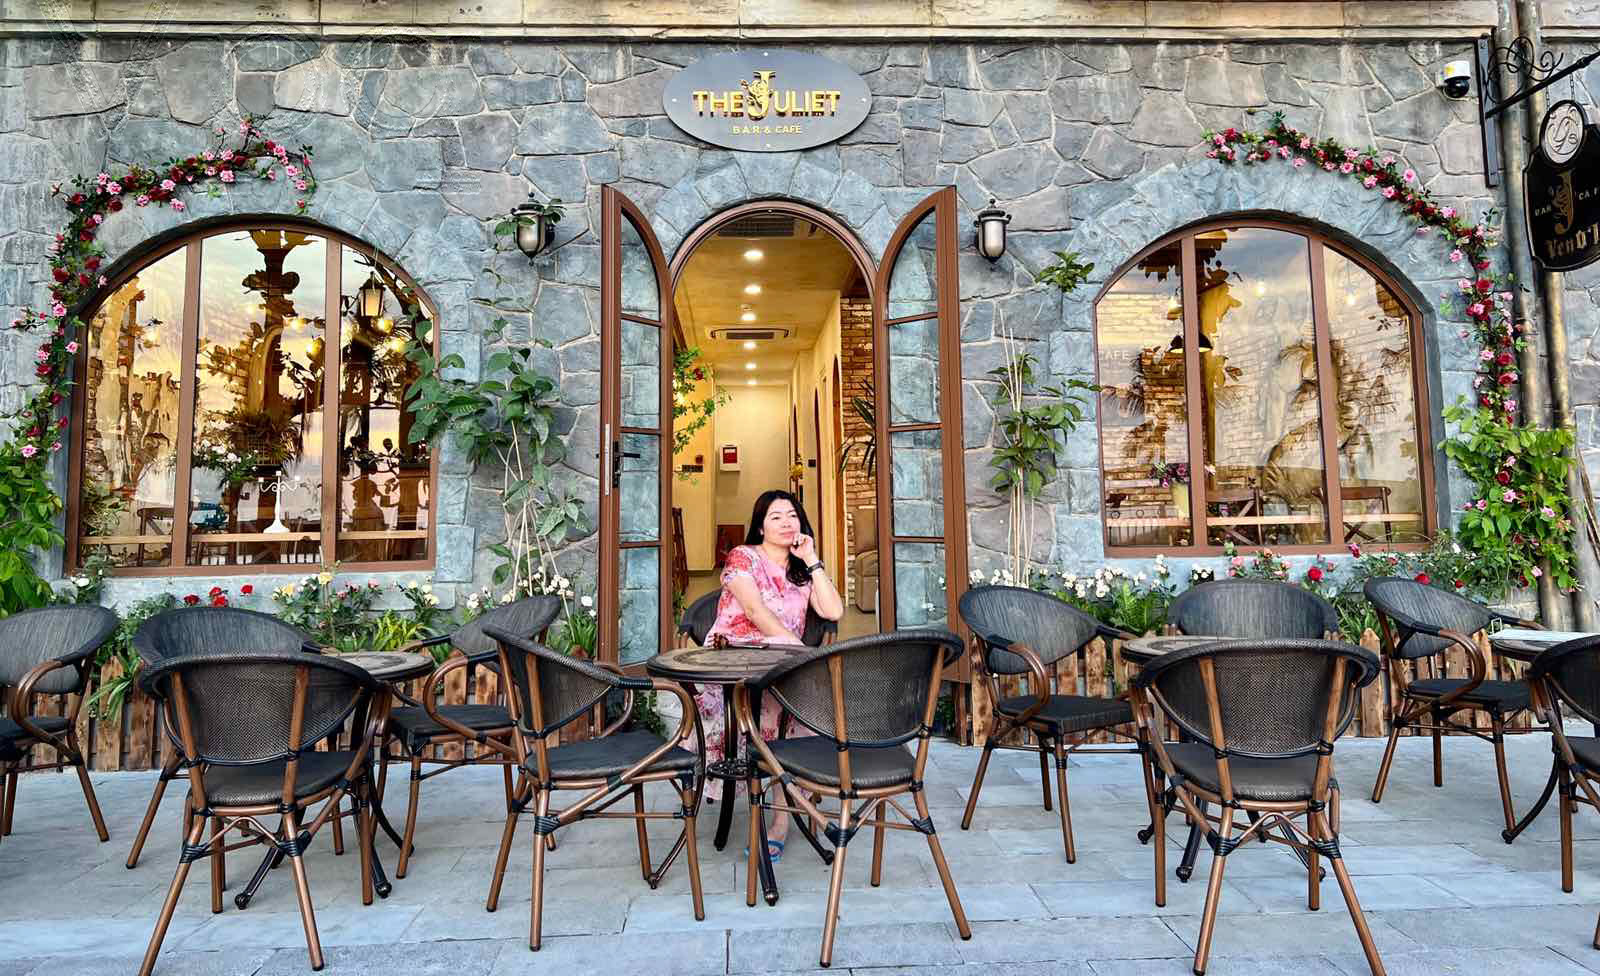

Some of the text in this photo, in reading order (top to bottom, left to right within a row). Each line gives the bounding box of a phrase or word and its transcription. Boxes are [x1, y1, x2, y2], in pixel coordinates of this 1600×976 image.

[692, 89, 744, 117] THE
[732, 125, 761, 135] BAR
[763, 125, 772, 135] &
